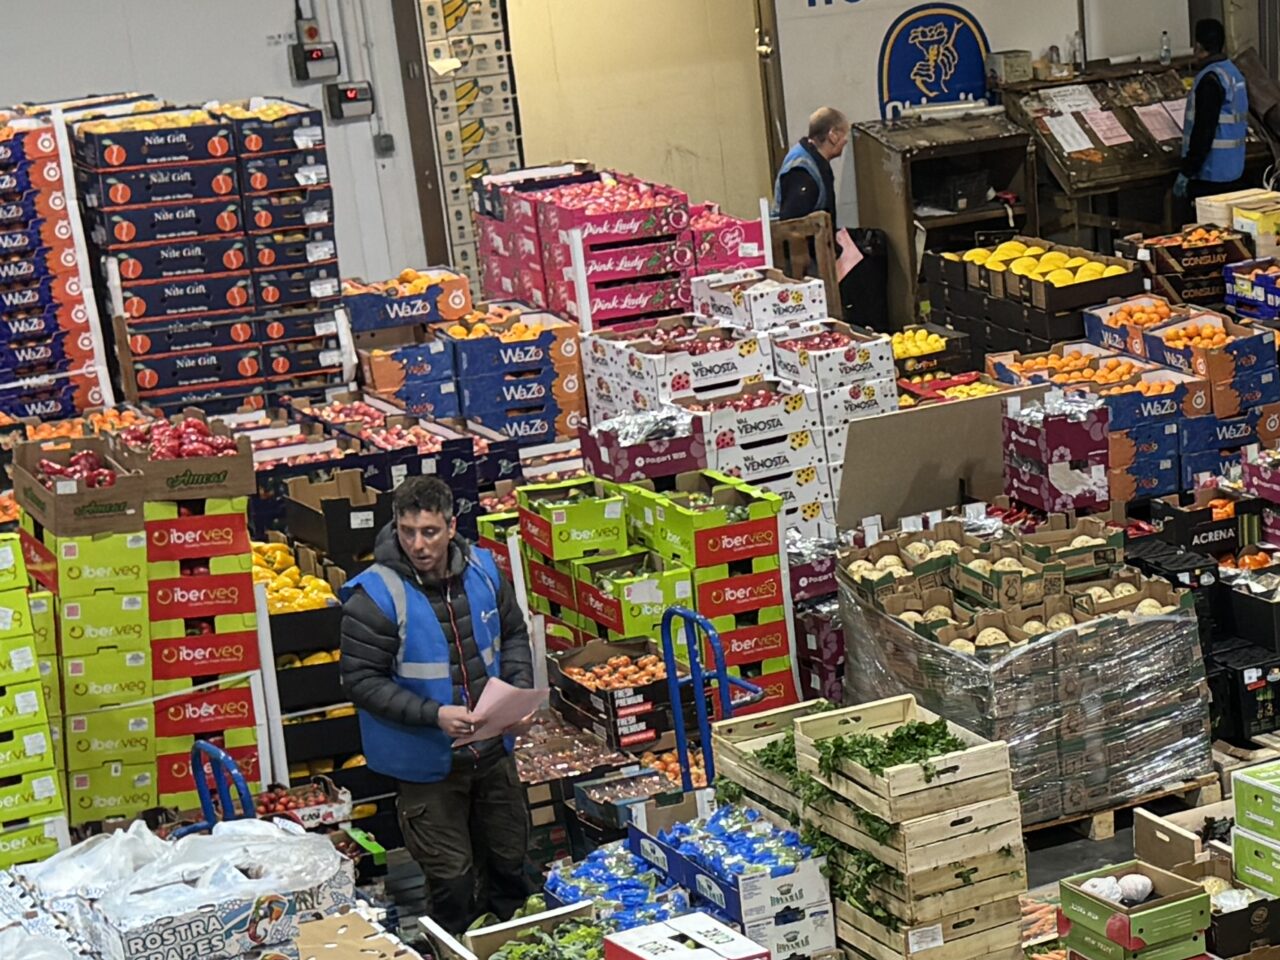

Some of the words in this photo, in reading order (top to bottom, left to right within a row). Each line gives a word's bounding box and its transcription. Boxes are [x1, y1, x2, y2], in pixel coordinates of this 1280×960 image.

[166, 133, 187, 143] Gift
[198, 356, 217, 365] Gift
[170, 526, 232, 543] iberveg
[723, 530, 773, 549] iberveg
[1192, 528, 1236, 545] ACRENA
[173, 585, 238, 604] iberveg
[724, 580, 777, 603] iberveg
[178, 643, 243, 660] iberveg
[615, 689, 634, 702] FRESH
[616, 695, 643, 708] PREMIUM
[618, 717, 636, 727] FRESH
[618, 721, 646, 734] PREMIUM
[128, 918, 224, 955] ROSTRA
